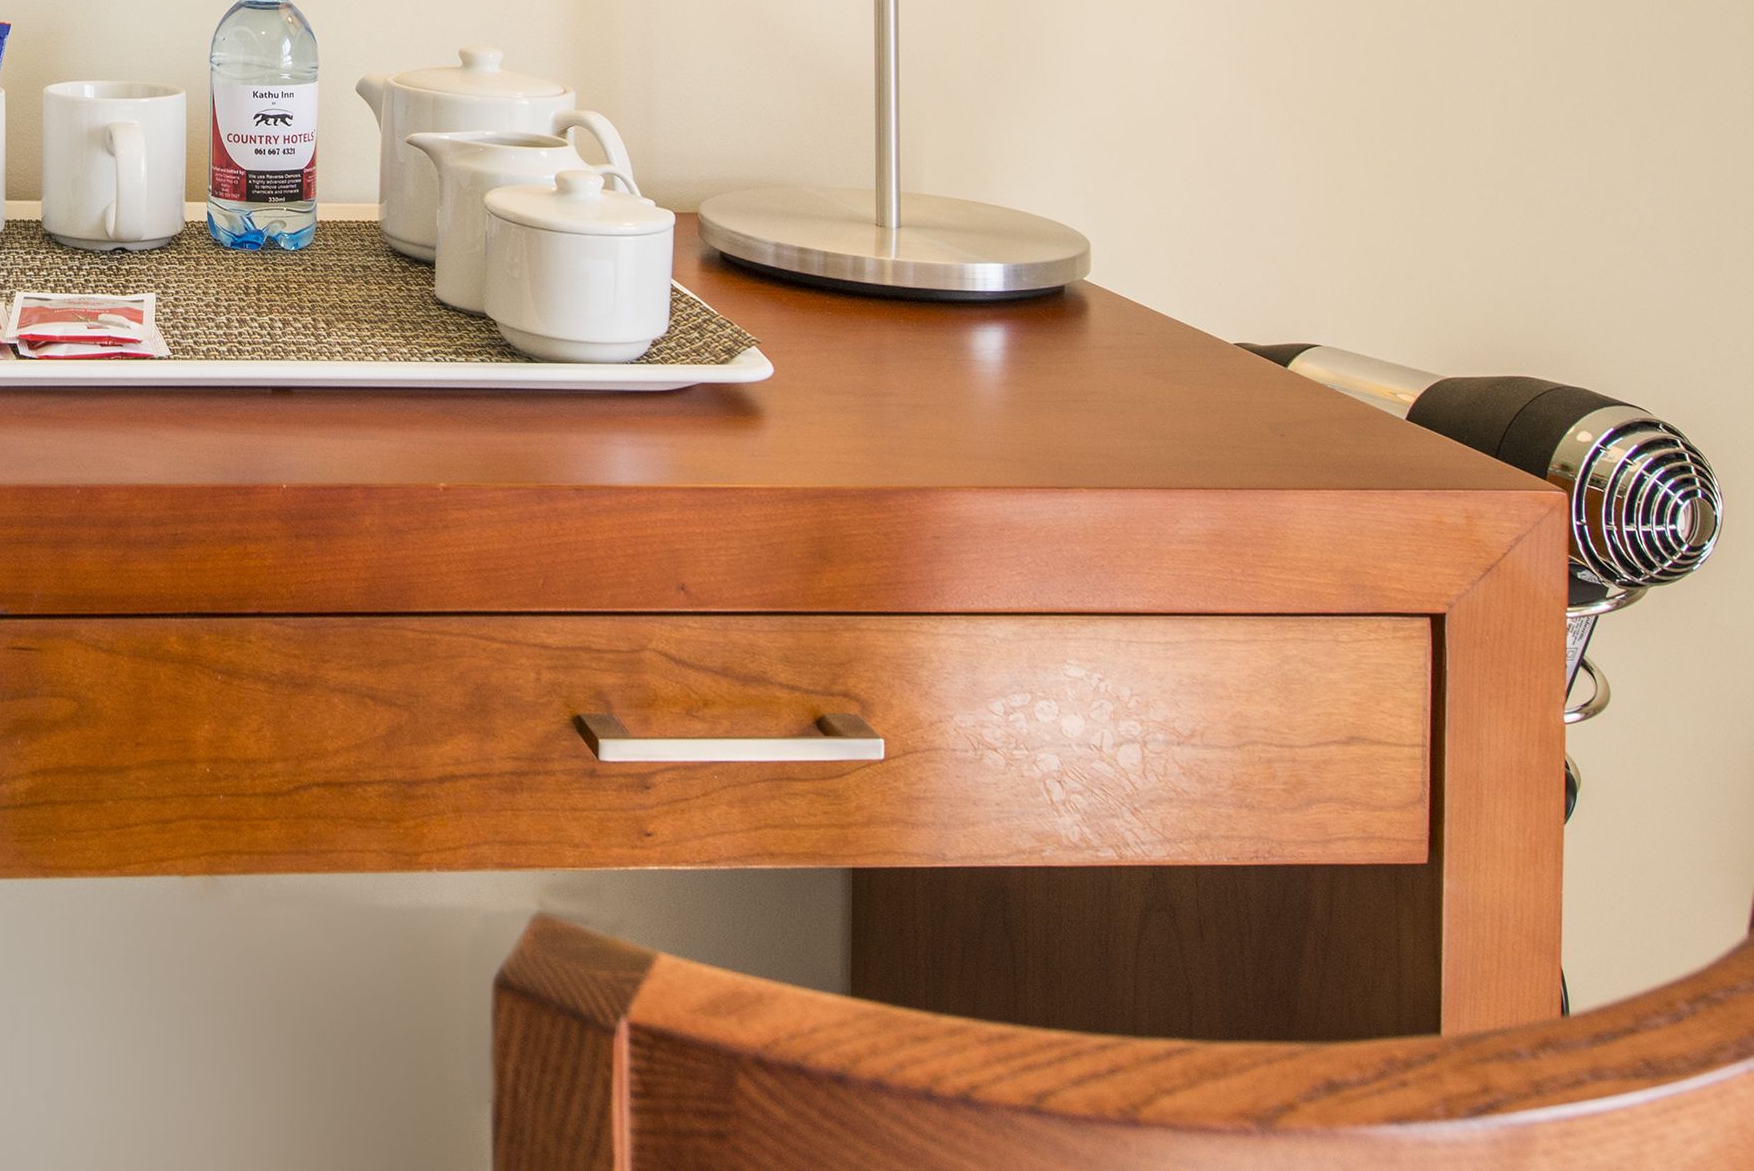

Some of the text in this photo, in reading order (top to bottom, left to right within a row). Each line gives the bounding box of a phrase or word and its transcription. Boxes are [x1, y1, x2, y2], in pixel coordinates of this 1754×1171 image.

[252, 91, 295, 99] Kathu Inn
[227, 132, 314, 144] COUNTRY HOTELS
